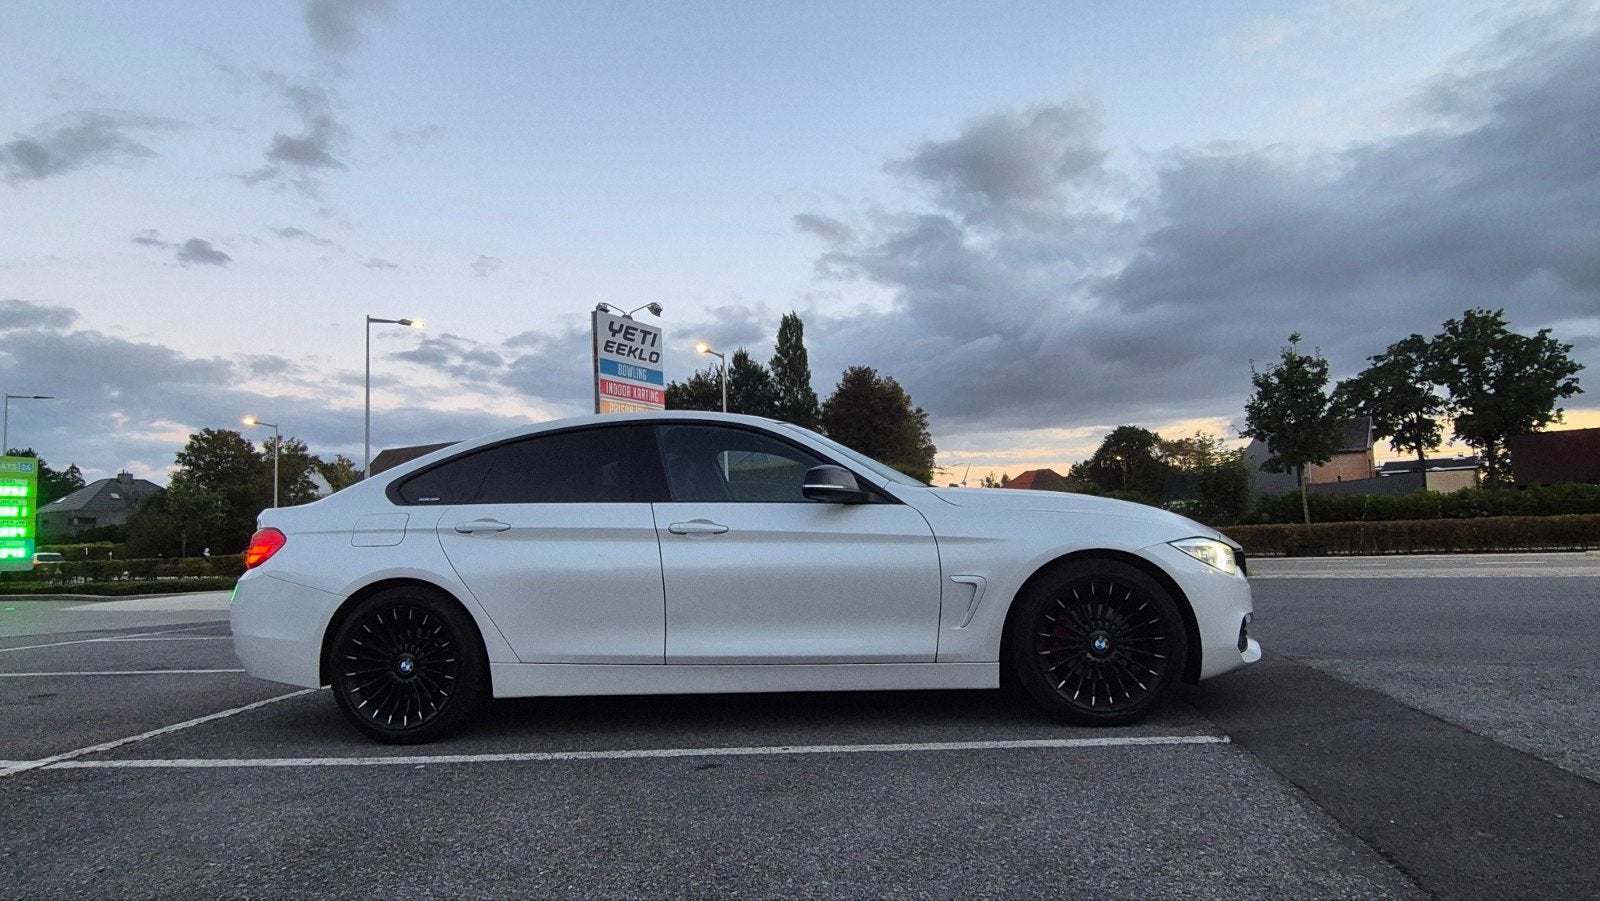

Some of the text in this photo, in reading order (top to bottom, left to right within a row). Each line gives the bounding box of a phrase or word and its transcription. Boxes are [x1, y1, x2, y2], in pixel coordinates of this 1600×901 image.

[608, 320, 658, 347] YETI
[603, 340, 660, 363] EEKLO
[617, 364, 647, 380] BOWLING
[606, 381, 659, 402] INDOOR KARTING
